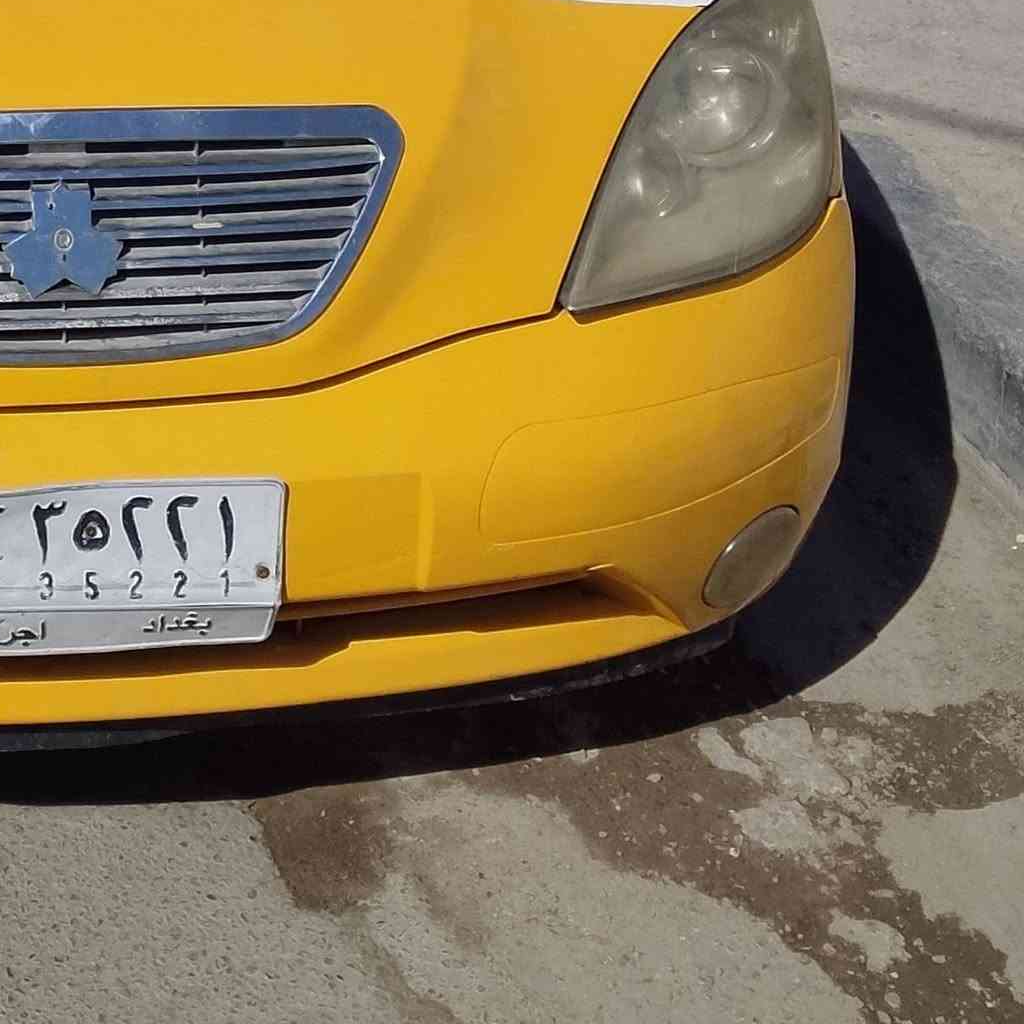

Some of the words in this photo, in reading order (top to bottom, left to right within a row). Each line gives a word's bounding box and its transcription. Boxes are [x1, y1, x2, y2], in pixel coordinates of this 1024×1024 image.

[32, 496, 235, 564] ٣٥٢٢١
[38, 570, 230, 600] 35221
[143, 610, 213, 636] بغداد
